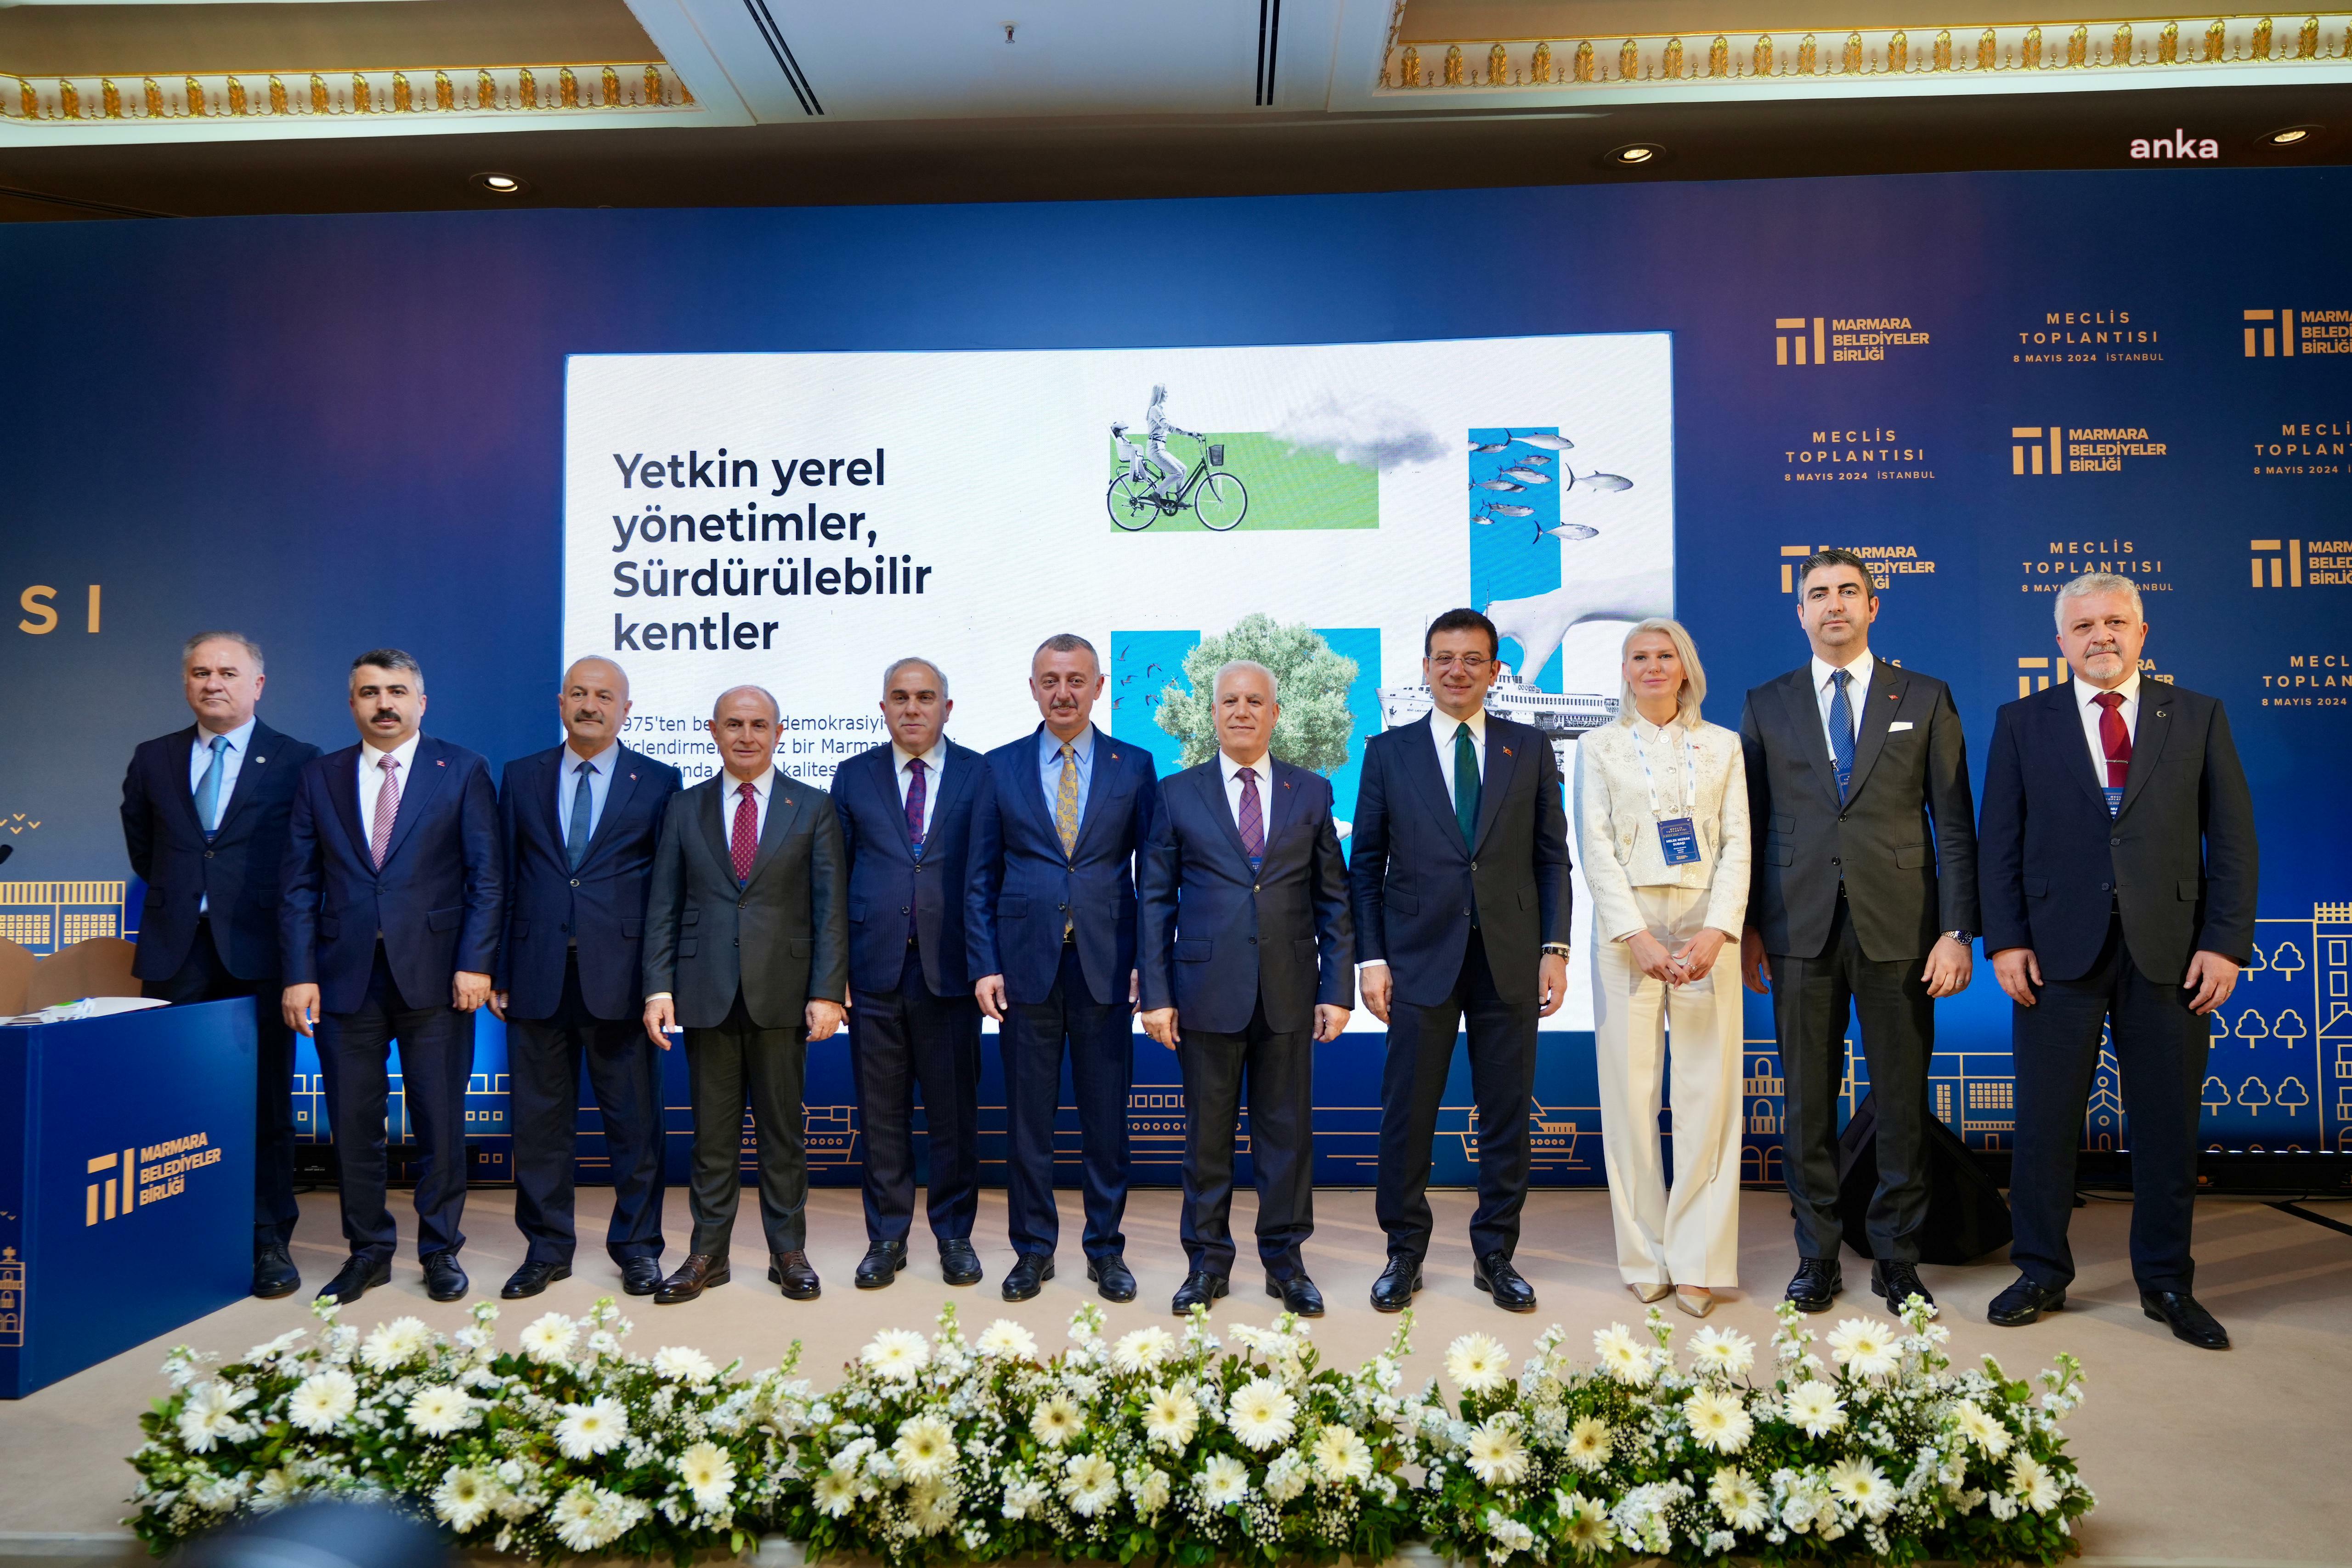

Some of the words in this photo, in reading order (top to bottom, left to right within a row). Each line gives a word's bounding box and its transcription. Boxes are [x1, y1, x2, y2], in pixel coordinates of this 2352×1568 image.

[2047, 310, 2130, 324] MECLİS
[2301, 311, 2352, 321] MARM
[1832, 318, 1911, 329] MARMARA
[1833, 331, 1930, 344] BELEDİYELER
[2019, 332, 2157, 344] TOPLANTISI
[1833, 346, 1884, 361] BİRLİĞİ
[1813, 429, 1896, 443] MECLİS
[2069, 429, 2148, 440] MARMARA
[2069, 442, 2166, 455] BELEDİYELER
[2255, 444, 2352, 456] TOPLAN
[1786, 450, 1923, 463] TOPLANTISI
[2070, 457, 2122, 471] BİRLİĞİ
[613, 448, 758, 489] Yetkin
[771, 448, 885, 497] yerel
[1877, 470, 1934, 479] İSTANBUL
[612, 502, 877, 553] yönetimler,
[2050, 540, 2133, 553] MECLİS
[2023, 561, 2161, 574] TOPLANTISI
[613, 555, 932, 598] Sürdürülebilir
[615, 612, 779, 651] kentler
[623, 716, 685, 732] 975'ten
[780, 715, 883, 734] demokrasiyi
[793, 738, 815, 754] bir
[141, 1132, 208, 1164] MARMARA
[140, 1147, 221, 1184] BELEDİYELER
[140, 1174, 185, 1207] BİRLİĞİ
